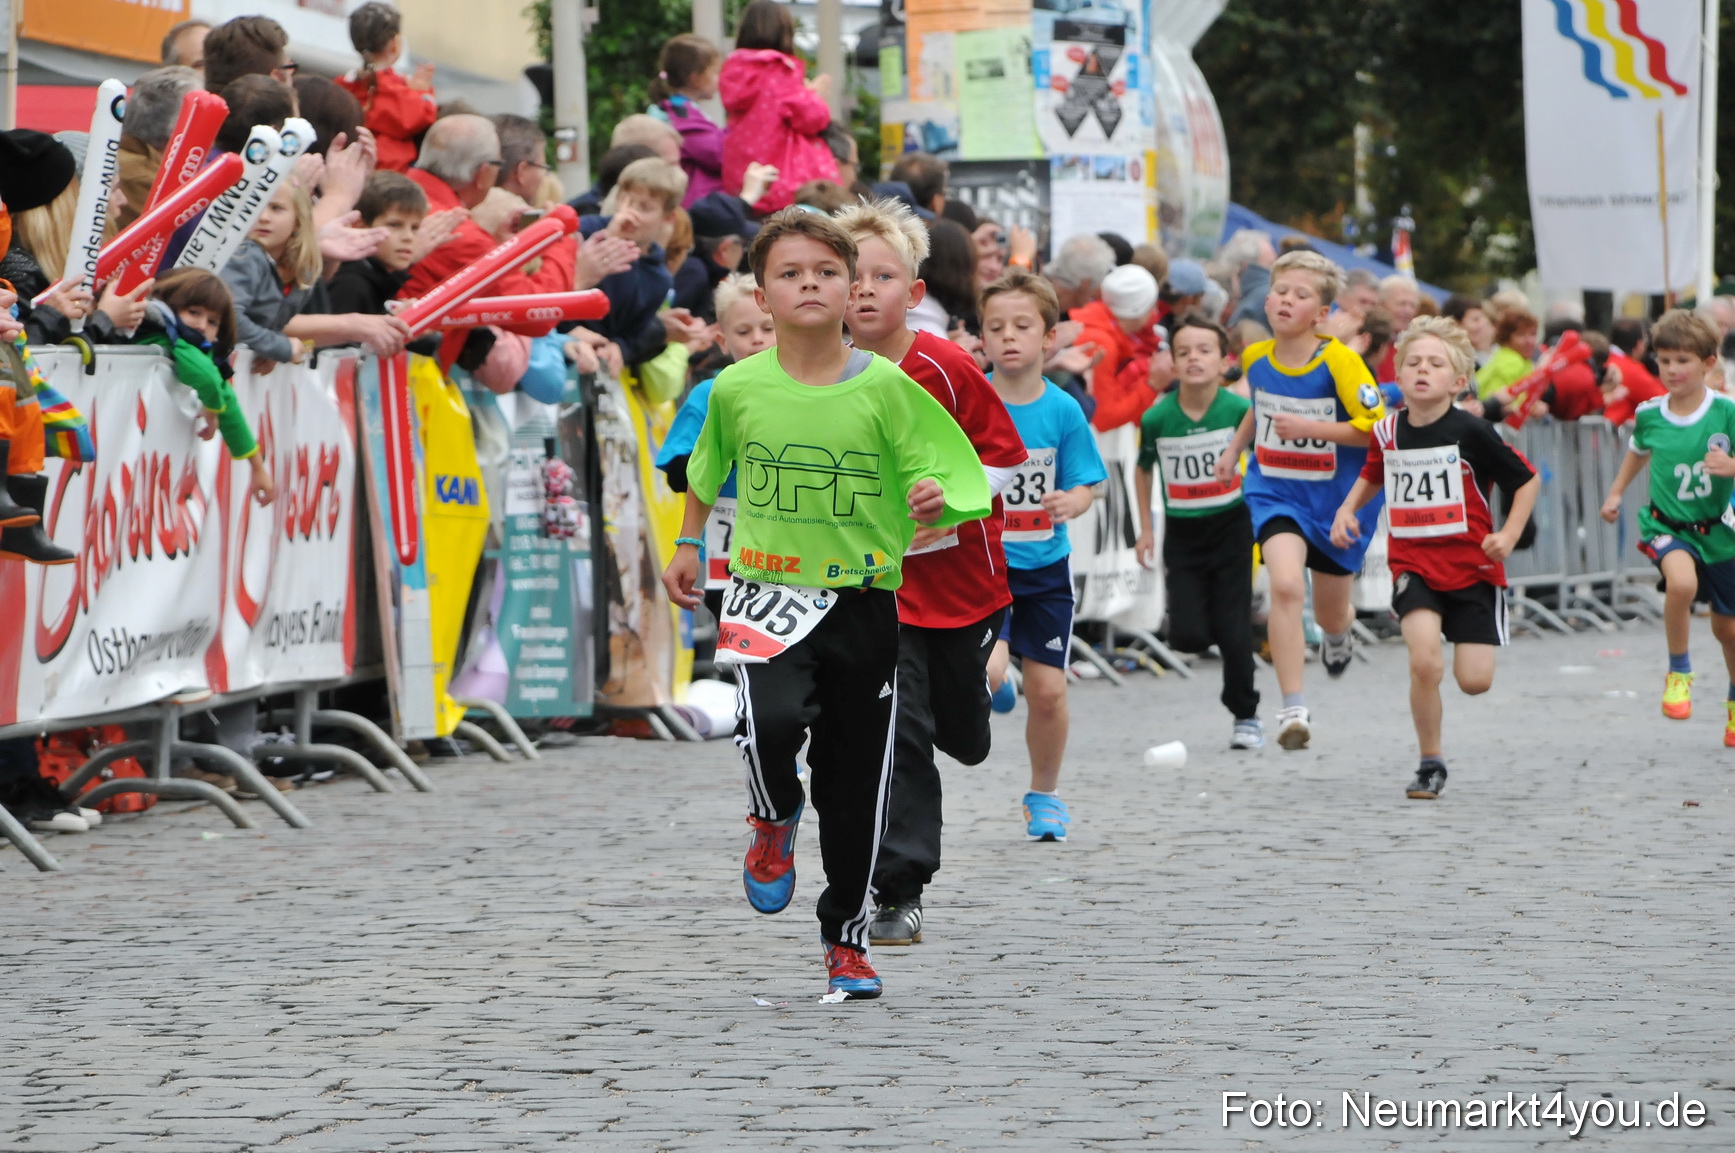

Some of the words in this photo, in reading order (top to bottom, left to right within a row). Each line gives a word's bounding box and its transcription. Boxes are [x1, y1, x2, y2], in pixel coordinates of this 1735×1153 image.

[1167, 449, 1225, 480] 708
[1401, 457, 1443, 467] Neumarkt
[1006, 471, 1047, 505] 33
[1392, 468, 1451, 502] 7241
[1673, 461, 1713, 501] 23
[1405, 512, 1435, 524] Julius
[739, 546, 801, 574] MERZ
[826, 564, 892, 578] Bretschneider
